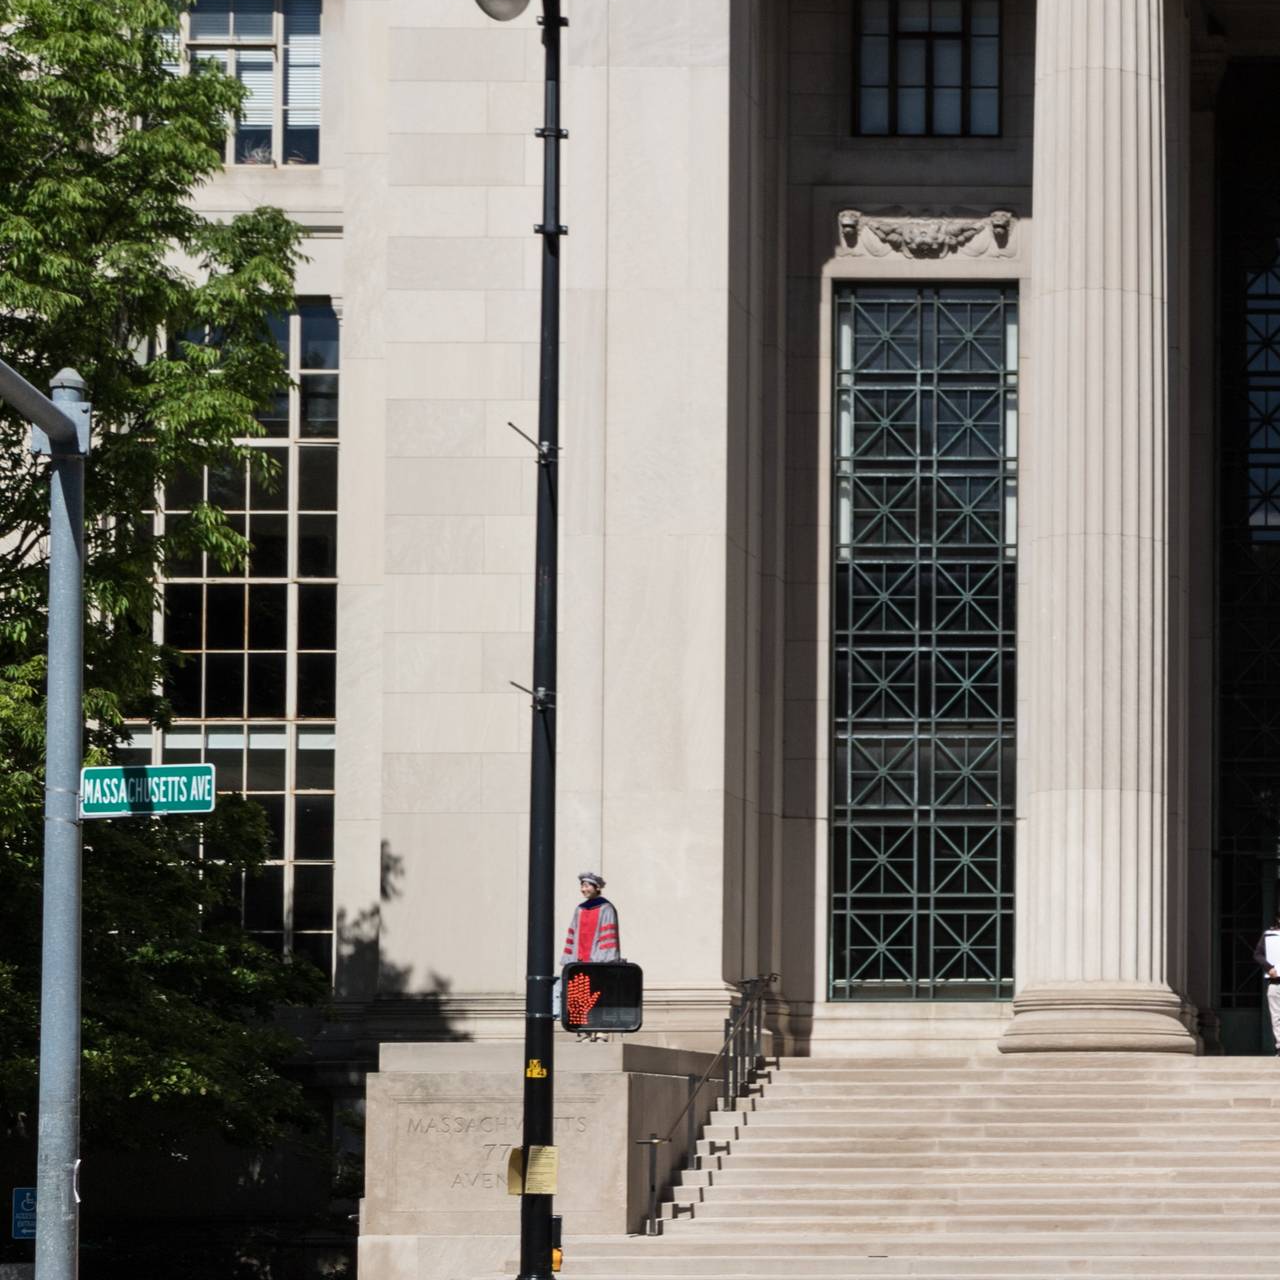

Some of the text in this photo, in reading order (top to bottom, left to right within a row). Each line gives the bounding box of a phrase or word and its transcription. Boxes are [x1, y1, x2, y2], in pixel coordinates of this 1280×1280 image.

[84, 775, 211, 803] MASSACHUSETTS AVE
[407, 1116, 586, 1135] MASSACHVTTS
[483, 1144, 512, 1162] 77
[450, 1173, 508, 1189] AVEN
